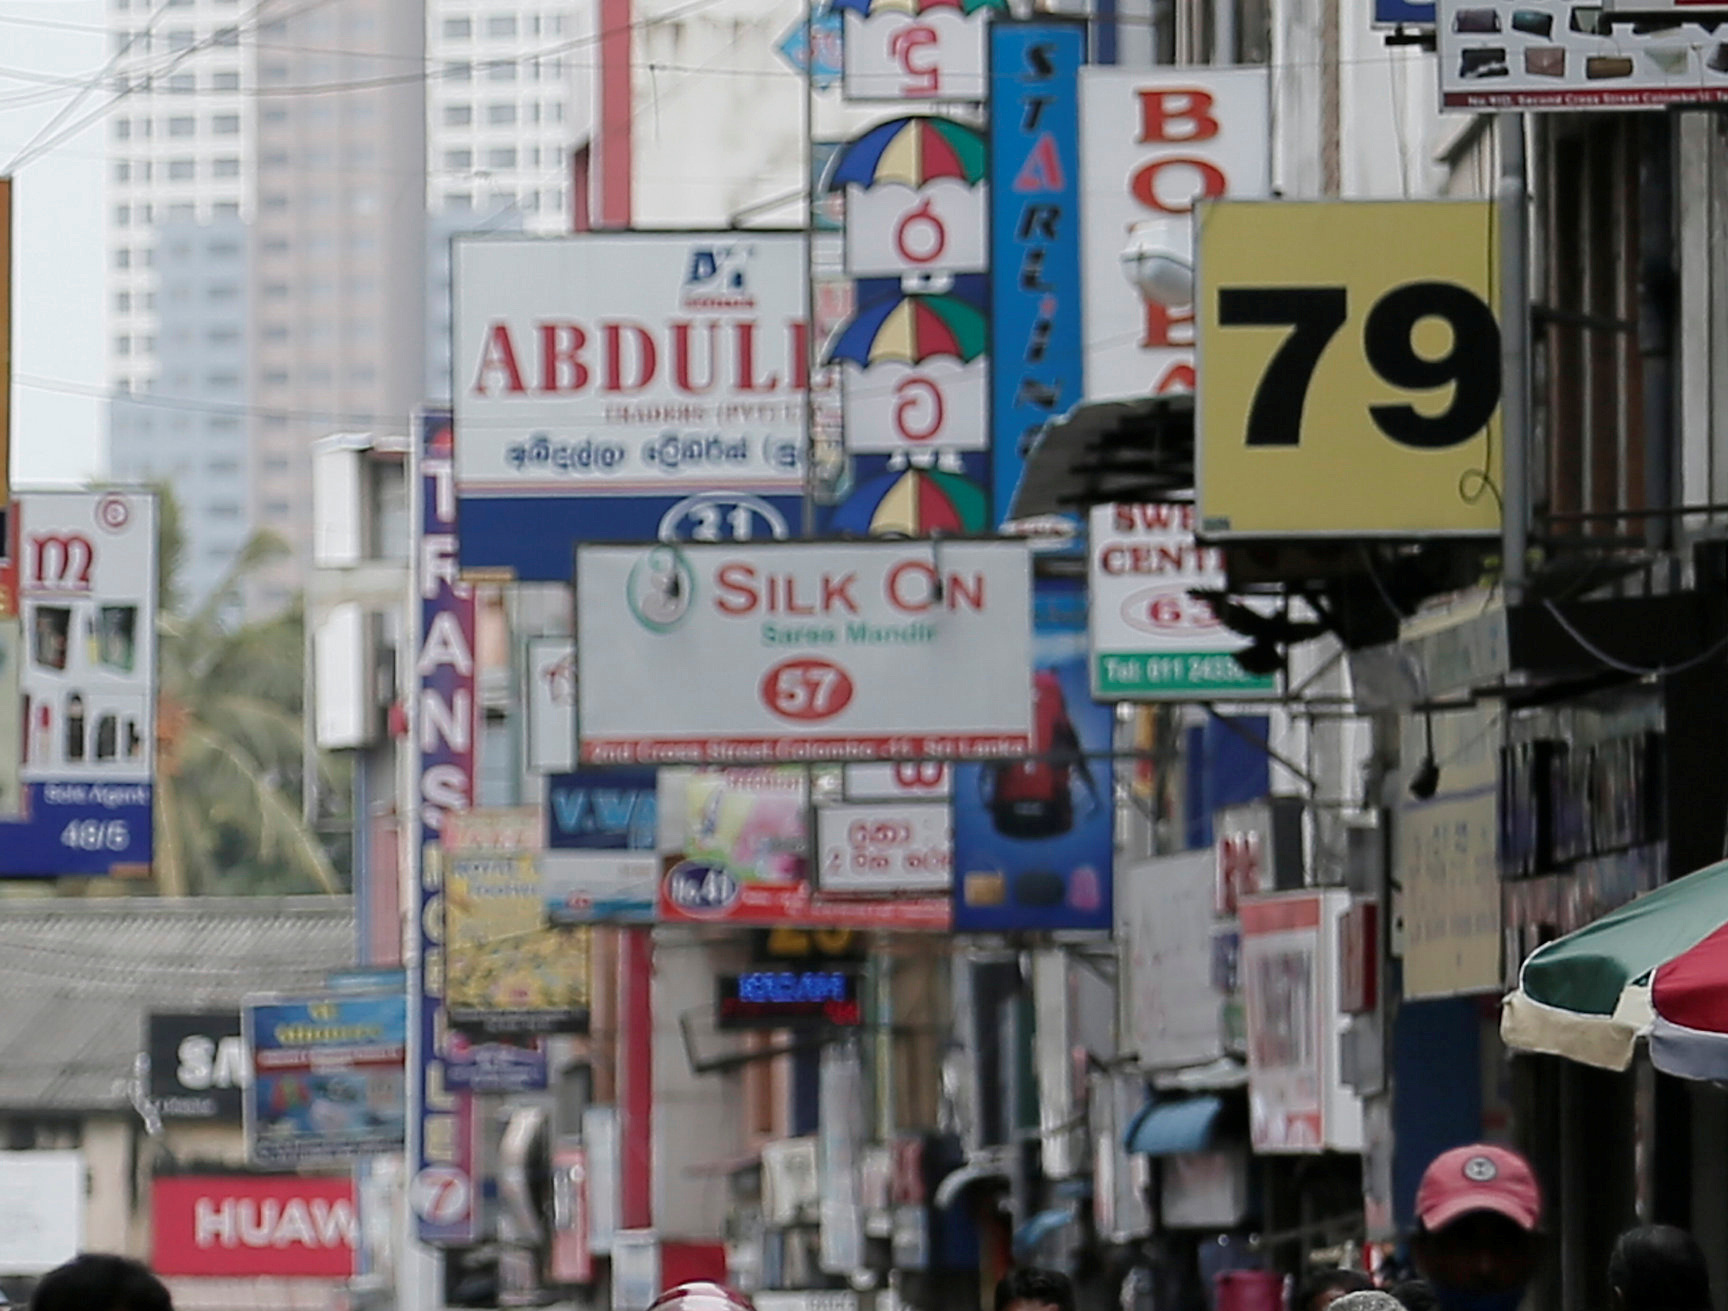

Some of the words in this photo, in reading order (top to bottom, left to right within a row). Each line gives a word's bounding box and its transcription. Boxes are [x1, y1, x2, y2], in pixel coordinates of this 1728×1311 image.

[1218, 280, 1502, 448] 79
[421, 459, 475, 828] TRANS
[778, 667, 839, 711] 57
